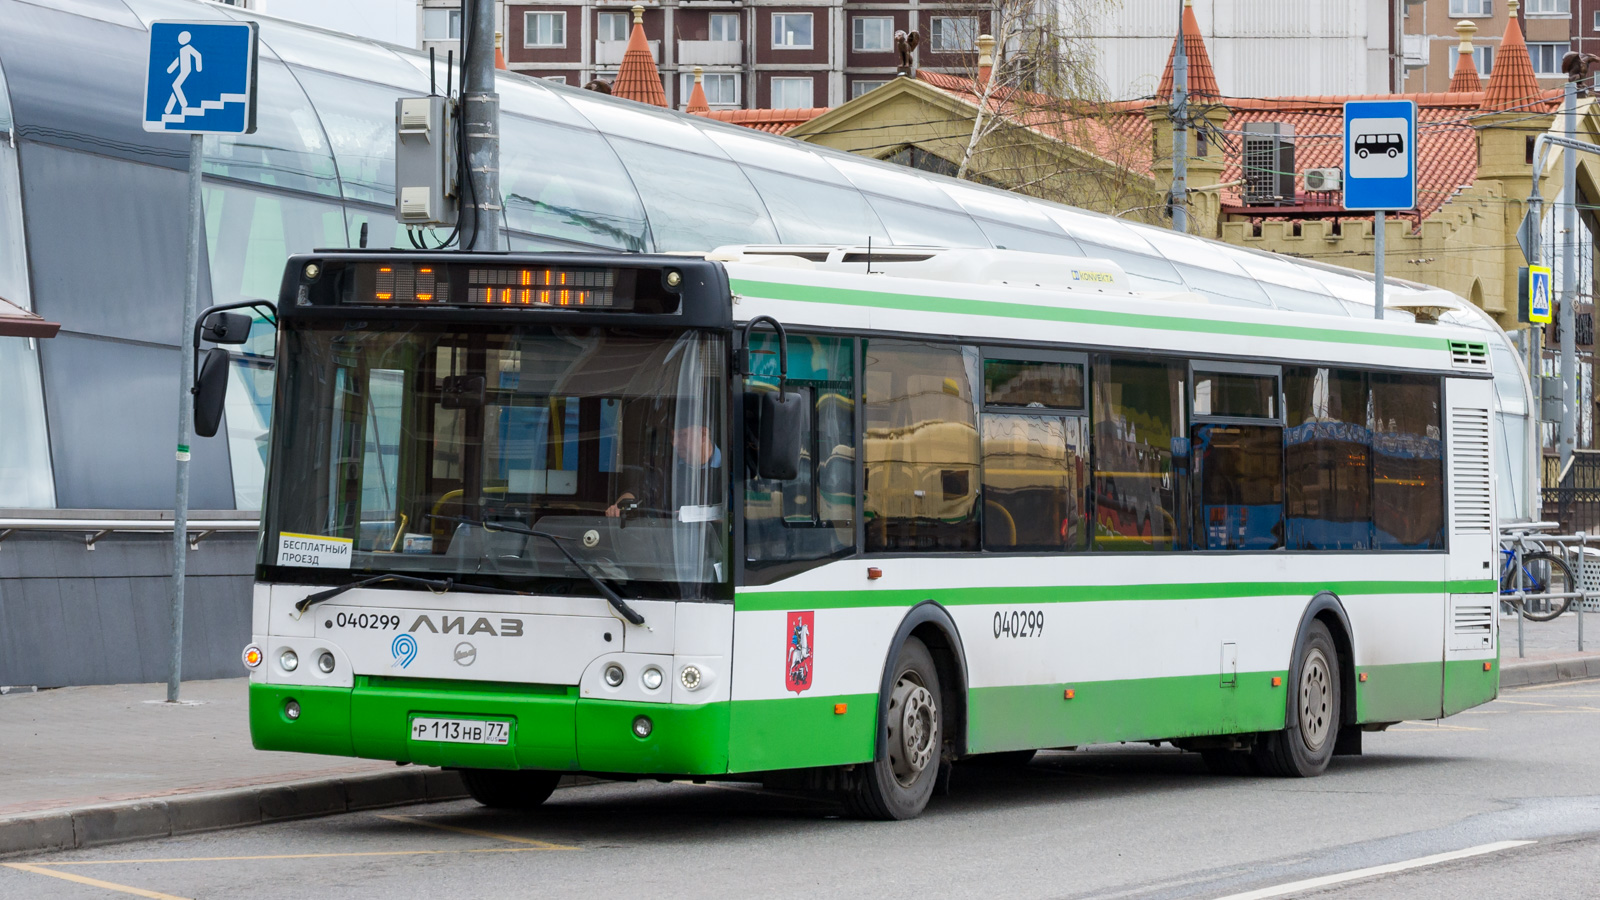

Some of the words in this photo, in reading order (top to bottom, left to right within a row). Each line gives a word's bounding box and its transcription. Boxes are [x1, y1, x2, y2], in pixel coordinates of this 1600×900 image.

[1080, 272, 1114, 283] KONVEKTA
[283, 540, 347, 555] БЕСПЛАТНЫЙ
[281, 553, 319, 566] ПРОЕЗД
[336, 612, 400, 630] 040299
[408, 615, 524, 637] ЛИАЗ
[993, 610, 1044, 639] 040299
